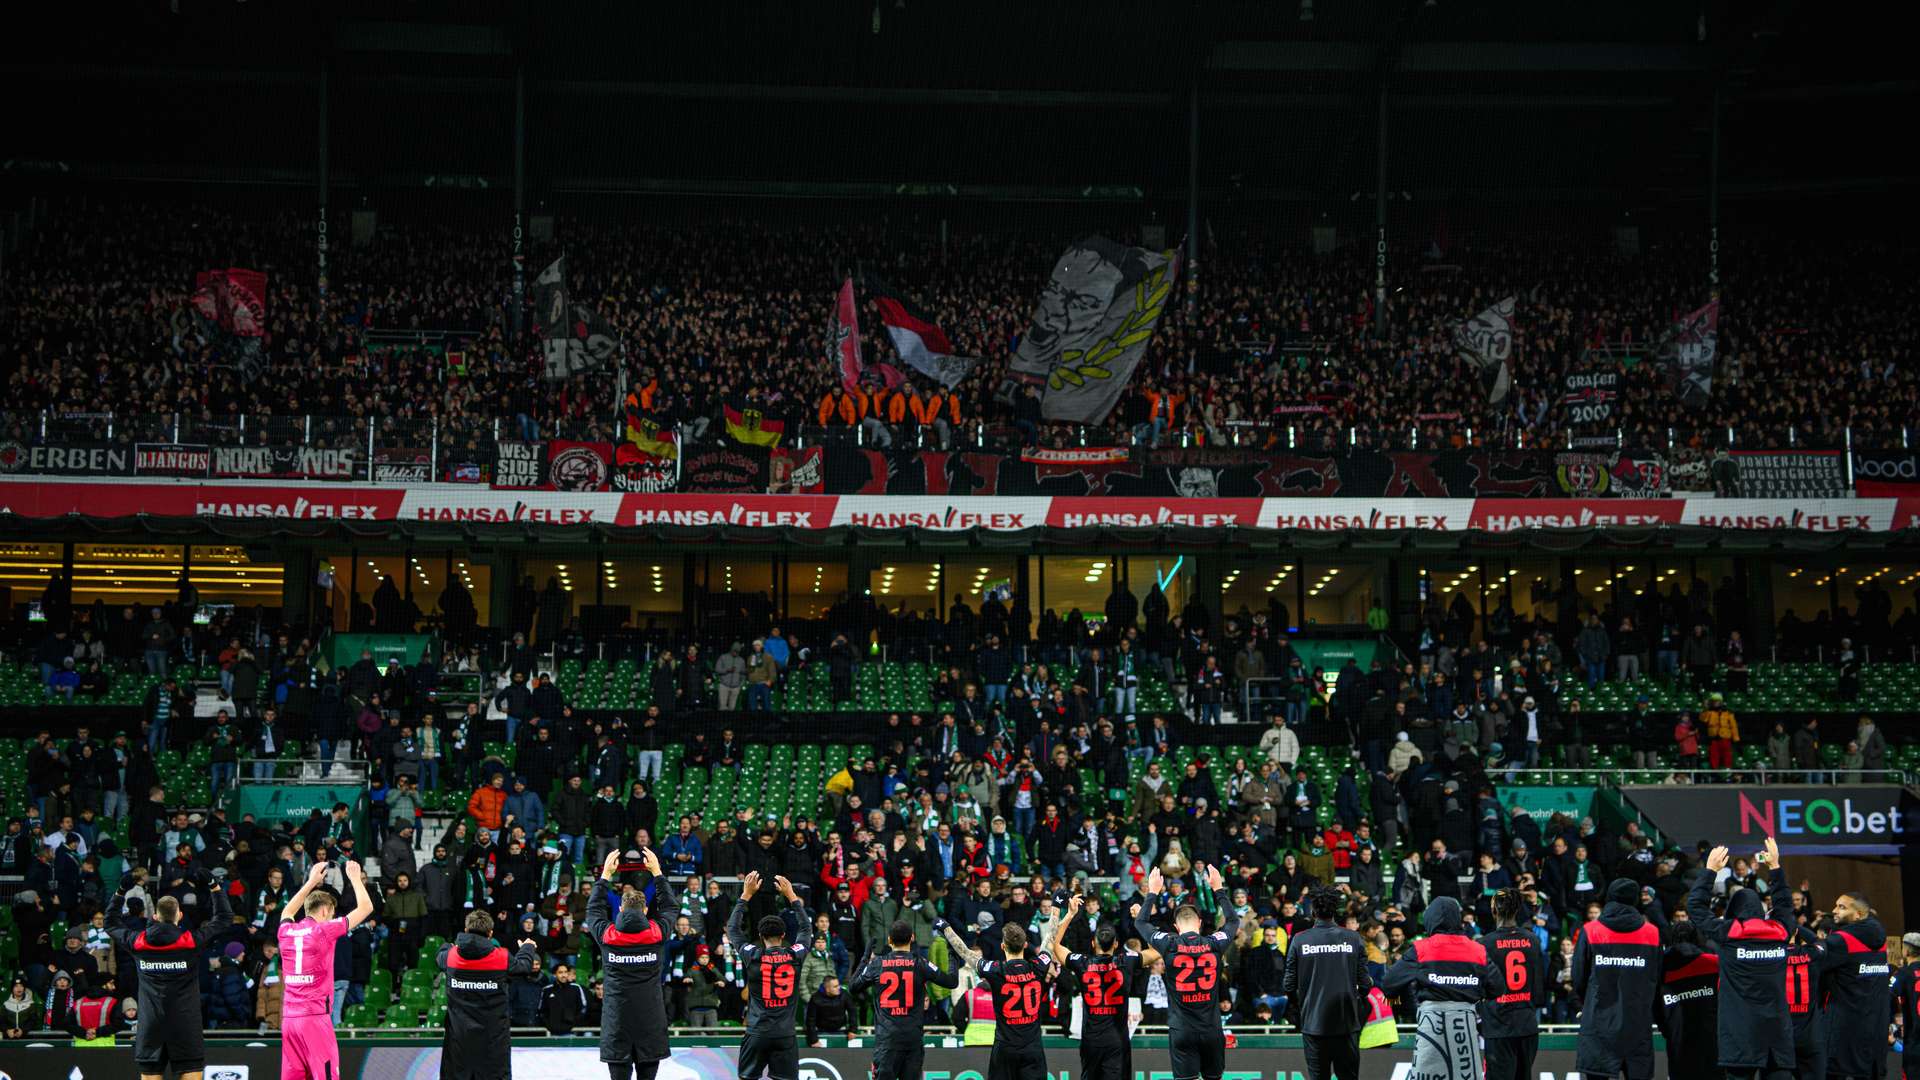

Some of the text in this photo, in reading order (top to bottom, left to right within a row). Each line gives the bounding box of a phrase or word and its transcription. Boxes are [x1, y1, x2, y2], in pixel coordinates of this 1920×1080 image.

[513, 212, 523, 254] 107
[1377, 228, 1386, 267] 103
[1572, 403, 1610, 423] 2009
[30, 447, 126, 471] ERBEN
[498, 443, 540, 460] WEST
[138, 450, 207, 470] DJANGOS
[497, 460, 539, 475] SIDE
[495, 474, 538, 488] BOYZ
[196, 502, 378, 520] HANSA FLEX
[418, 508, 594, 524] HANSA FLEX
[635, 510, 811, 528] HANSA FLEX
[852, 513, 1024, 529] HANSA FLEX
[1064, 513, 1238, 528] HANSA FLEX
[1277, 515, 1448, 530] HANSA FLEX
[1488, 515, 1660, 531] HANSA FLEX
[1699, 515, 1872, 531] HANSA FLEX
[287, 929, 312, 976] 1
[1301, 942, 1353, 955] Barmenia
[1736, 946, 1786, 961] Barmenia
[139, 959, 187, 971] Barmenia
[608, 952, 657, 964] Barmenia
[1595, 954, 1646, 967] Barmenia
[1172, 952, 1217, 992] 23
[1505, 950, 1527, 991] 6
[450, 978, 499, 991] Barmenia
[760, 964, 796, 1000] 19
[1082, 969, 1125, 1006] 32
[1427, 972, 1480, 987] Barmenia
[880, 971, 914, 1009] 21
[1663, 984, 1715, 1006] Barmenia
[764, 999, 789, 1008] TELLA
[1001, 980, 1041, 1018] 20
[890, 1007, 909, 1016] ADLI
